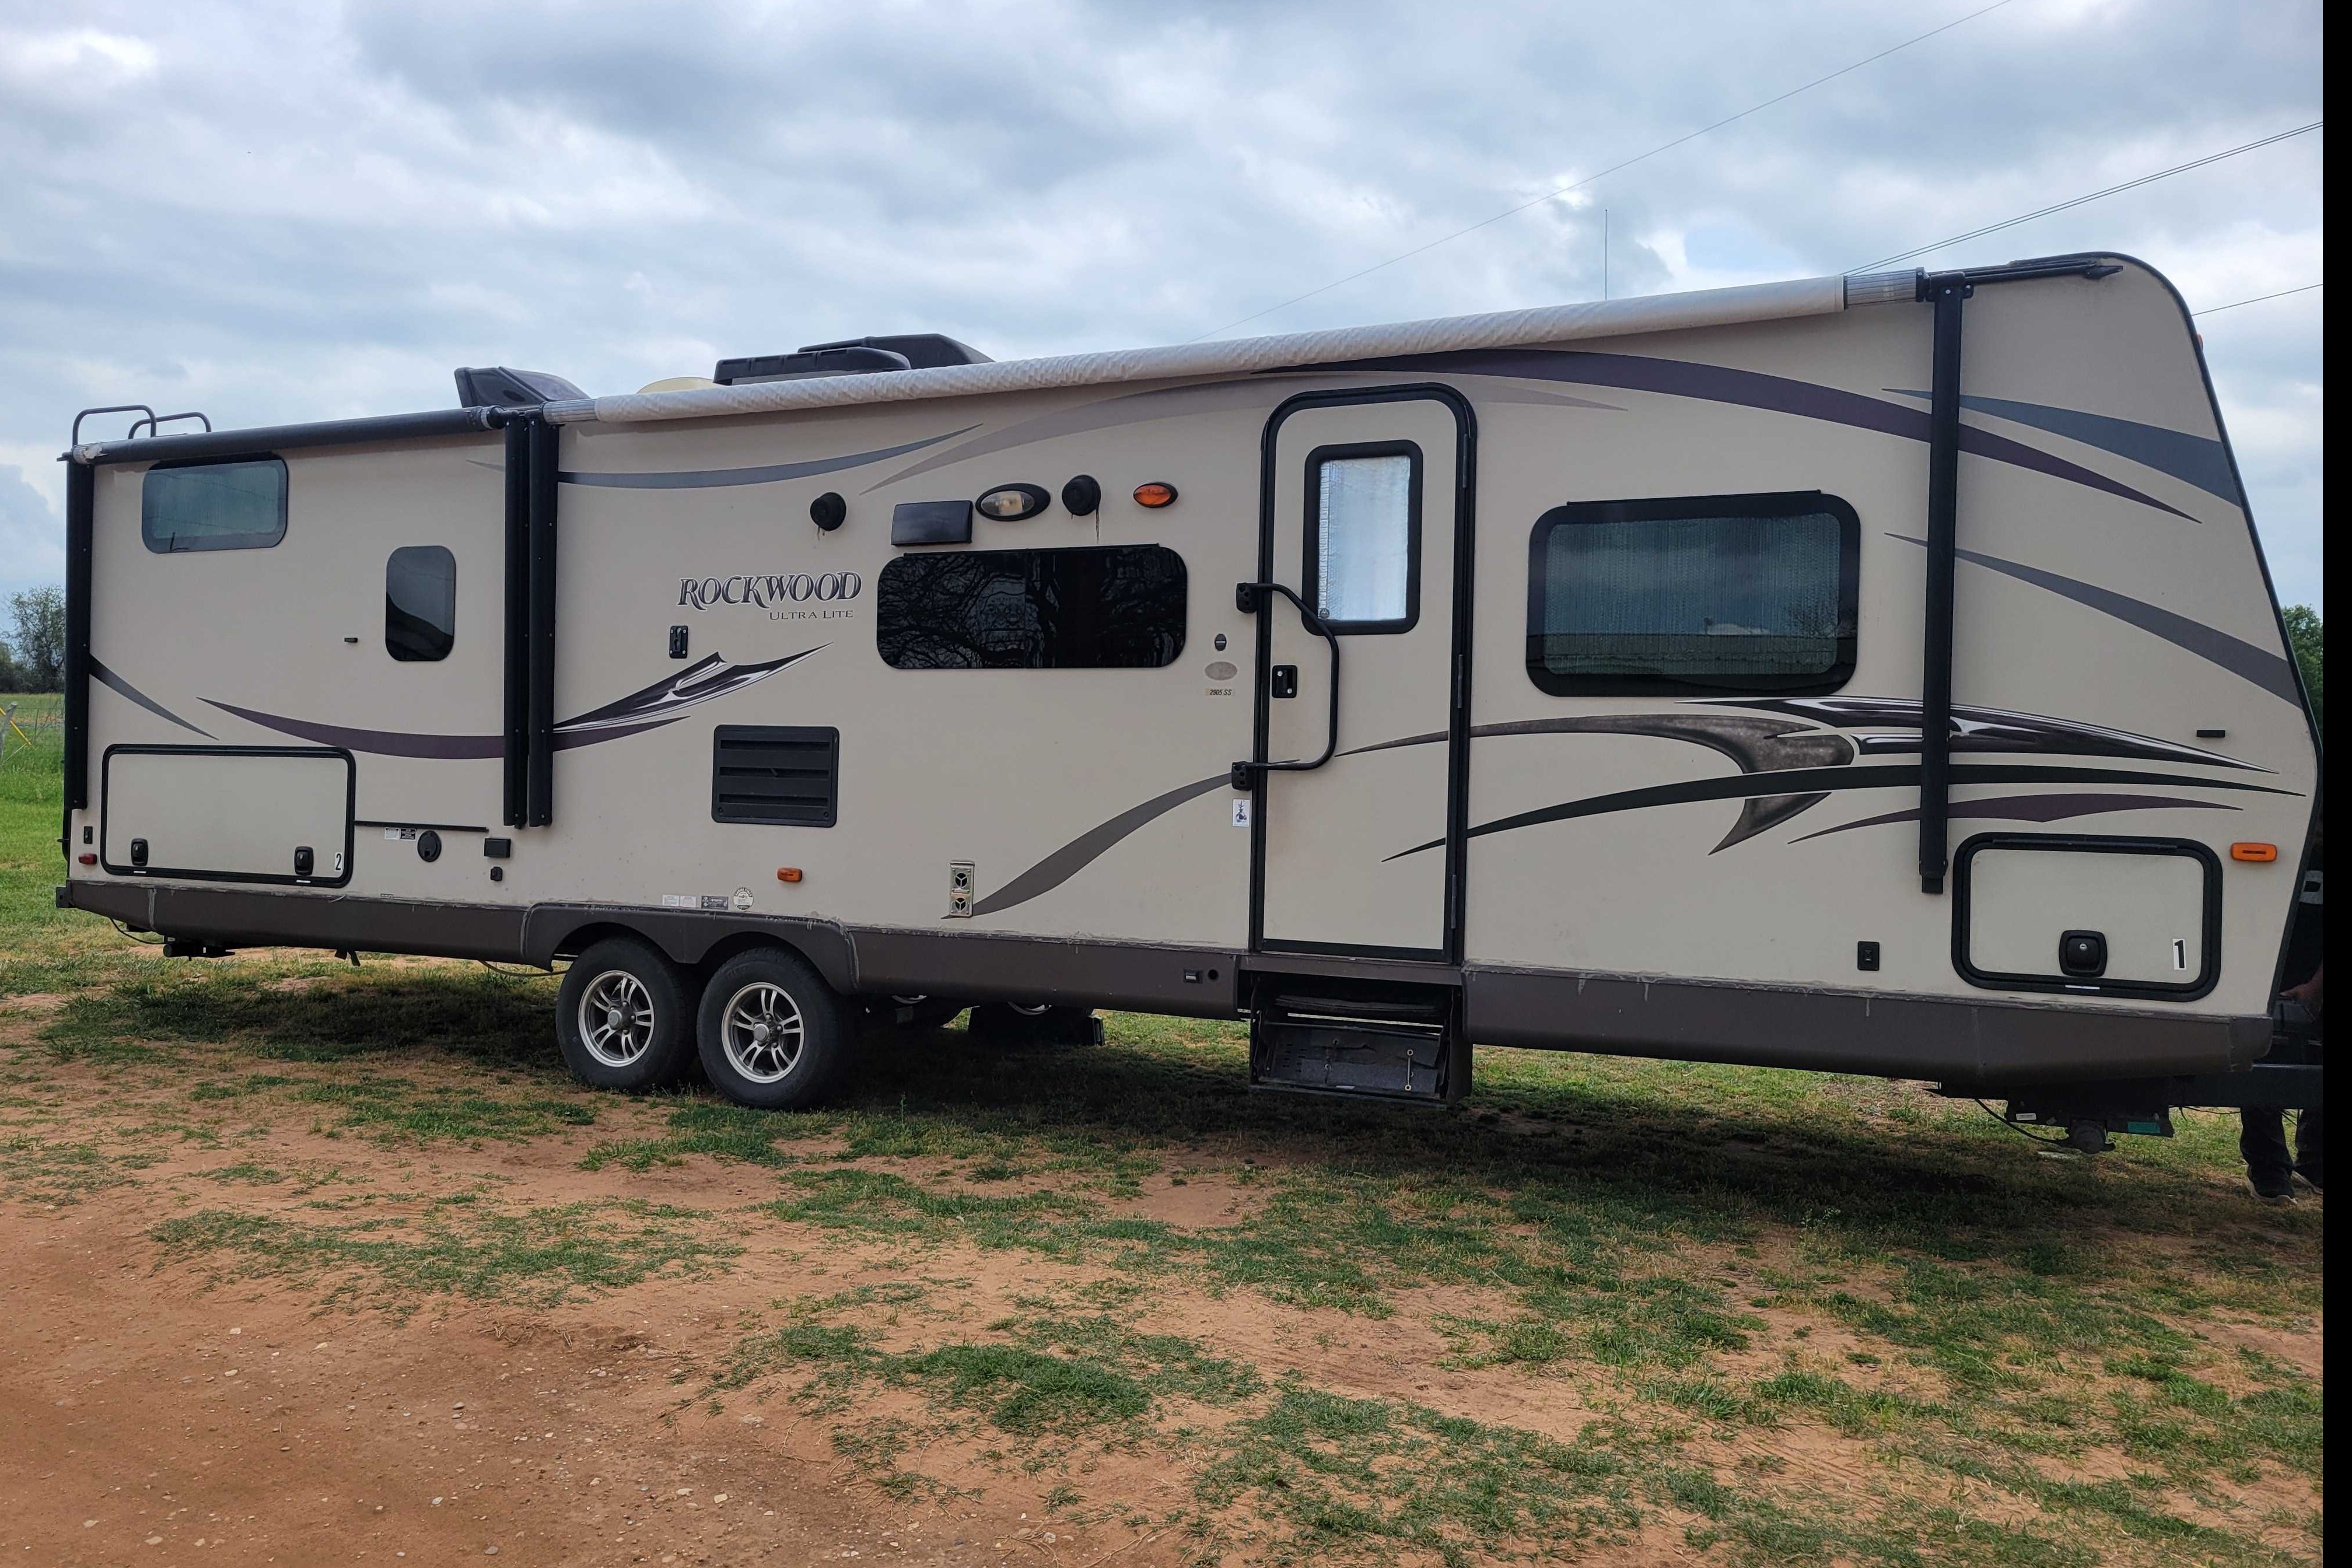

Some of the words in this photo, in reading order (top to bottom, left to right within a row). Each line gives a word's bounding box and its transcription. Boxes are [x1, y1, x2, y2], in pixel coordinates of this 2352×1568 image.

[677, 572, 862, 611] ROCKWOOD
[769, 611, 817, 621] ULTRA
[822, 610, 853, 619] LITE
[335, 853, 342, 871] 2
[2174, 939, 2185, 969] 1
